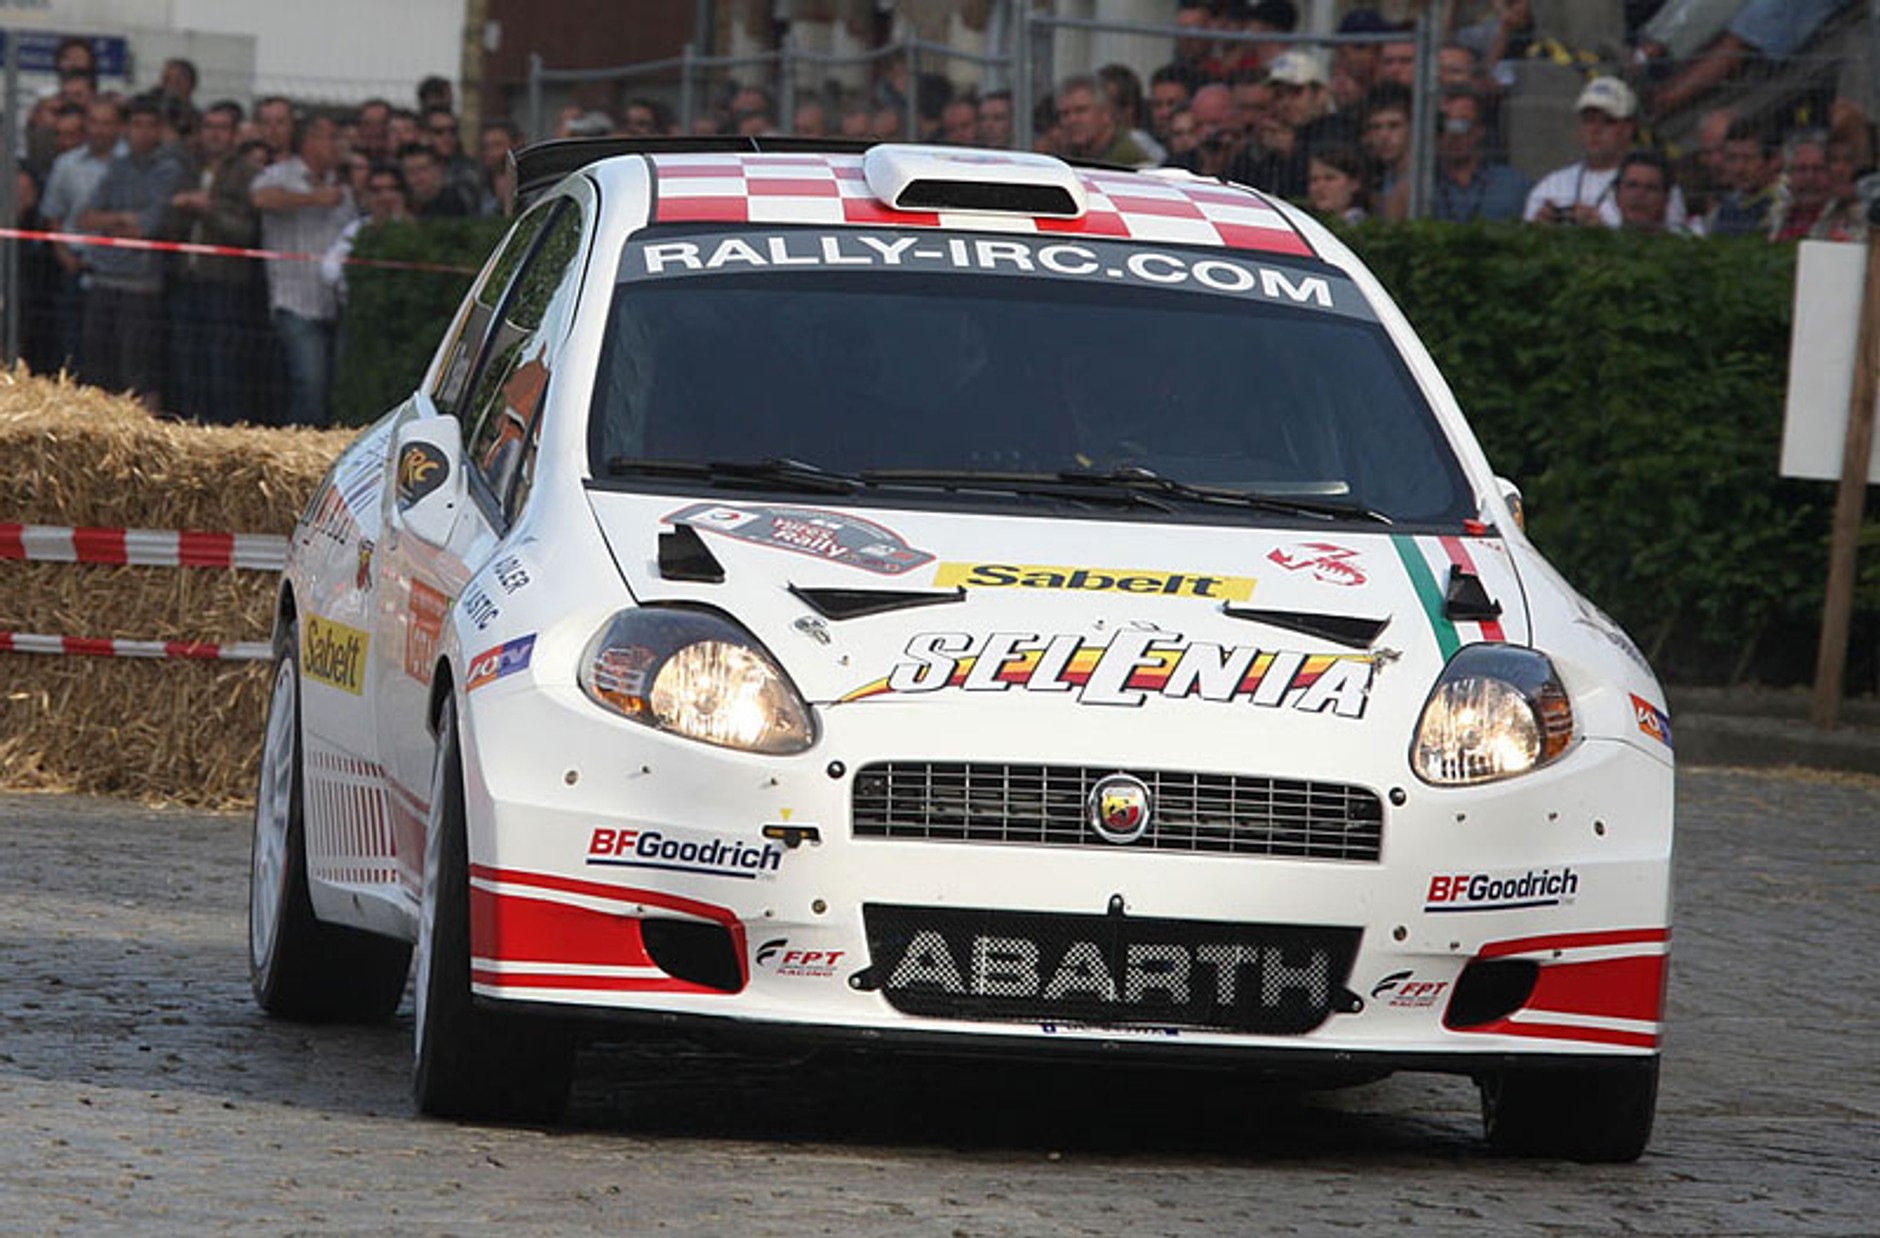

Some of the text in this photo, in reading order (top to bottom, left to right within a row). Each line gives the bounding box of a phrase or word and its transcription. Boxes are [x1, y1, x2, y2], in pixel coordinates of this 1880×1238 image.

[643, 235, 1335, 308] RALLY-IRC.COM
[967, 563, 1225, 598] Sabelt
[303, 619, 361, 688] Sabelt
[588, 827, 782, 871] BFGoodrich
[1426, 867, 1579, 903] BFGoodrich
[782, 951, 846, 966] FPT
[886, 930, 1330, 1009] ABARTH
[1399, 981, 1449, 997] FPT
